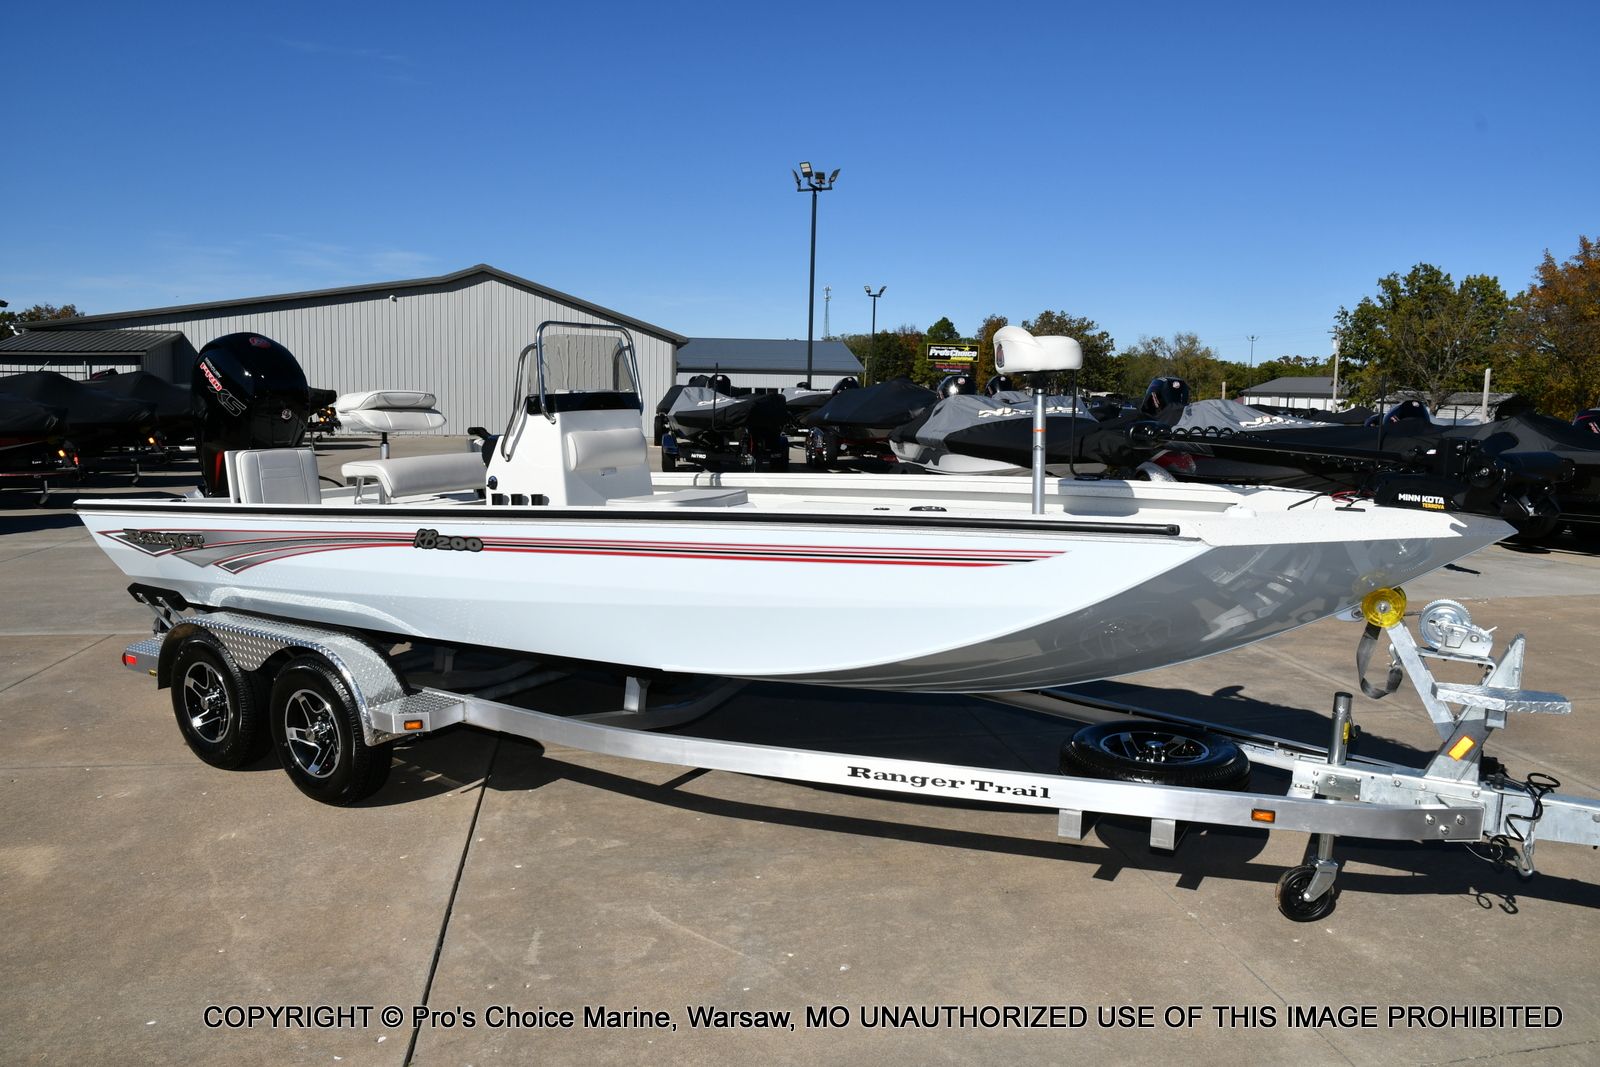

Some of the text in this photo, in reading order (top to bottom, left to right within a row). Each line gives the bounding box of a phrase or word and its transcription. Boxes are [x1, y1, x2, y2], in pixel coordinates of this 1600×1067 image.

[200, 362, 247, 416] PRO XS
[1398, 493, 1445, 504] MINN KOTA
[123, 528, 205, 551] Ranger
[847, 765, 1051, 799] Ranger Trail
